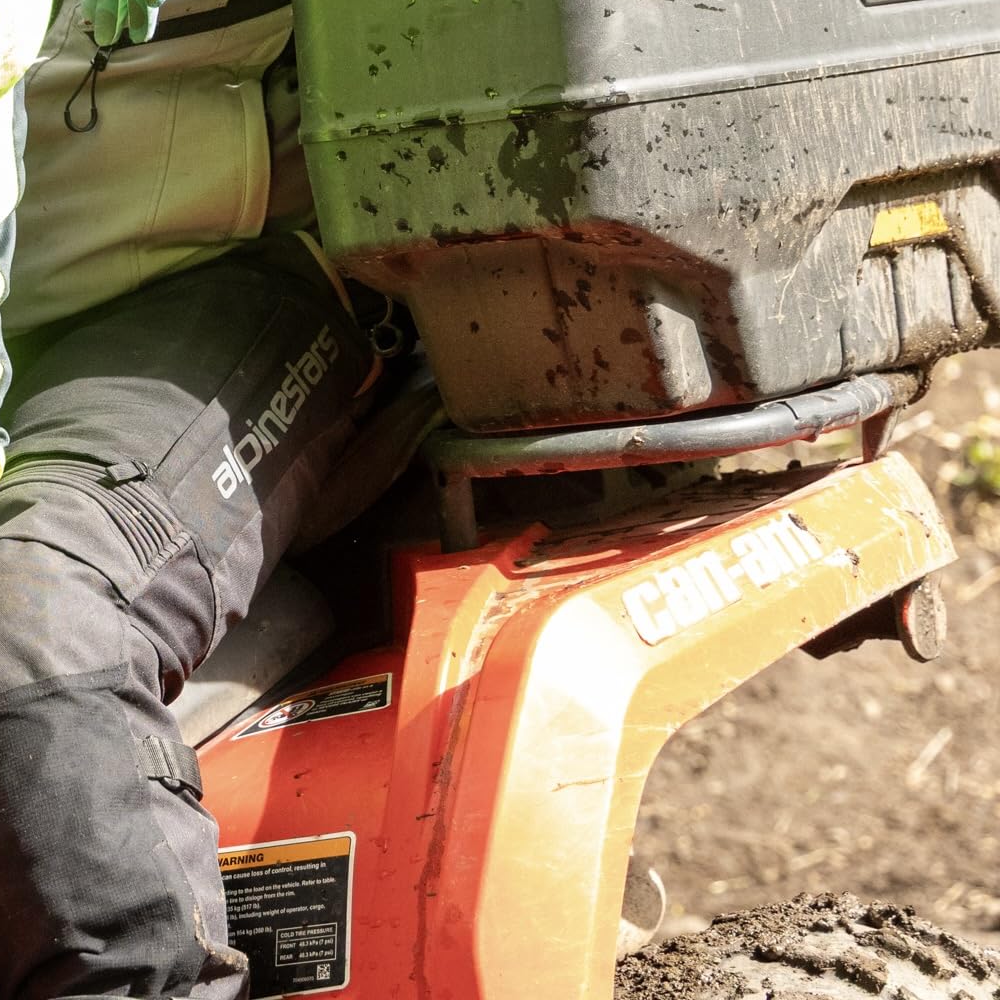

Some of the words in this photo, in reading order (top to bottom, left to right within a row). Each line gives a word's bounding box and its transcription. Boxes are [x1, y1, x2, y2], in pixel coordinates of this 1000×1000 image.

[211, 324, 339, 499] alpinestars
[621, 510, 824, 646] can-am
[233, 871, 250, 879] cause
[294, 862, 319, 871] resulting
